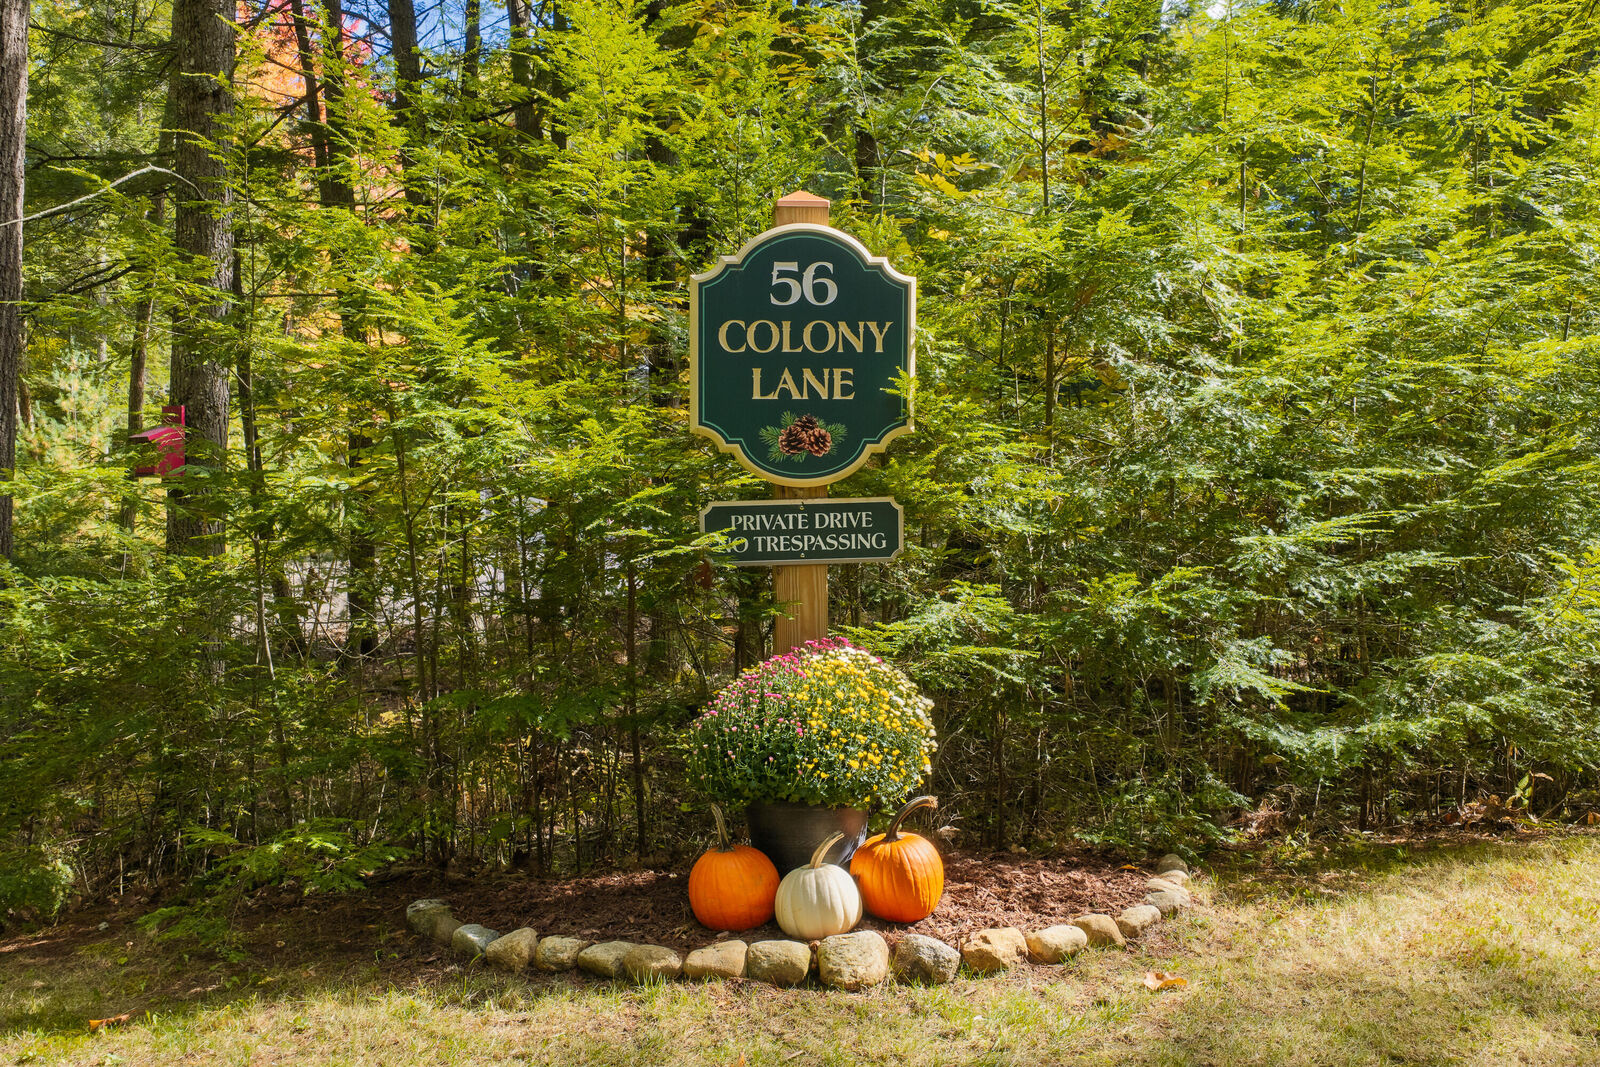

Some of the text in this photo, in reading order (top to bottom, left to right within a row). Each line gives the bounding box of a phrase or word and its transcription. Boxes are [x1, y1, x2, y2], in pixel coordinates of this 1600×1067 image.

[769, 261, 838, 306] 56
[718, 319, 893, 353] COLONY
[751, 367, 856, 400] LANE
[730, 511, 873, 531] PRIVATE DRIVE
[753, 532, 887, 552] TRESPASSING
